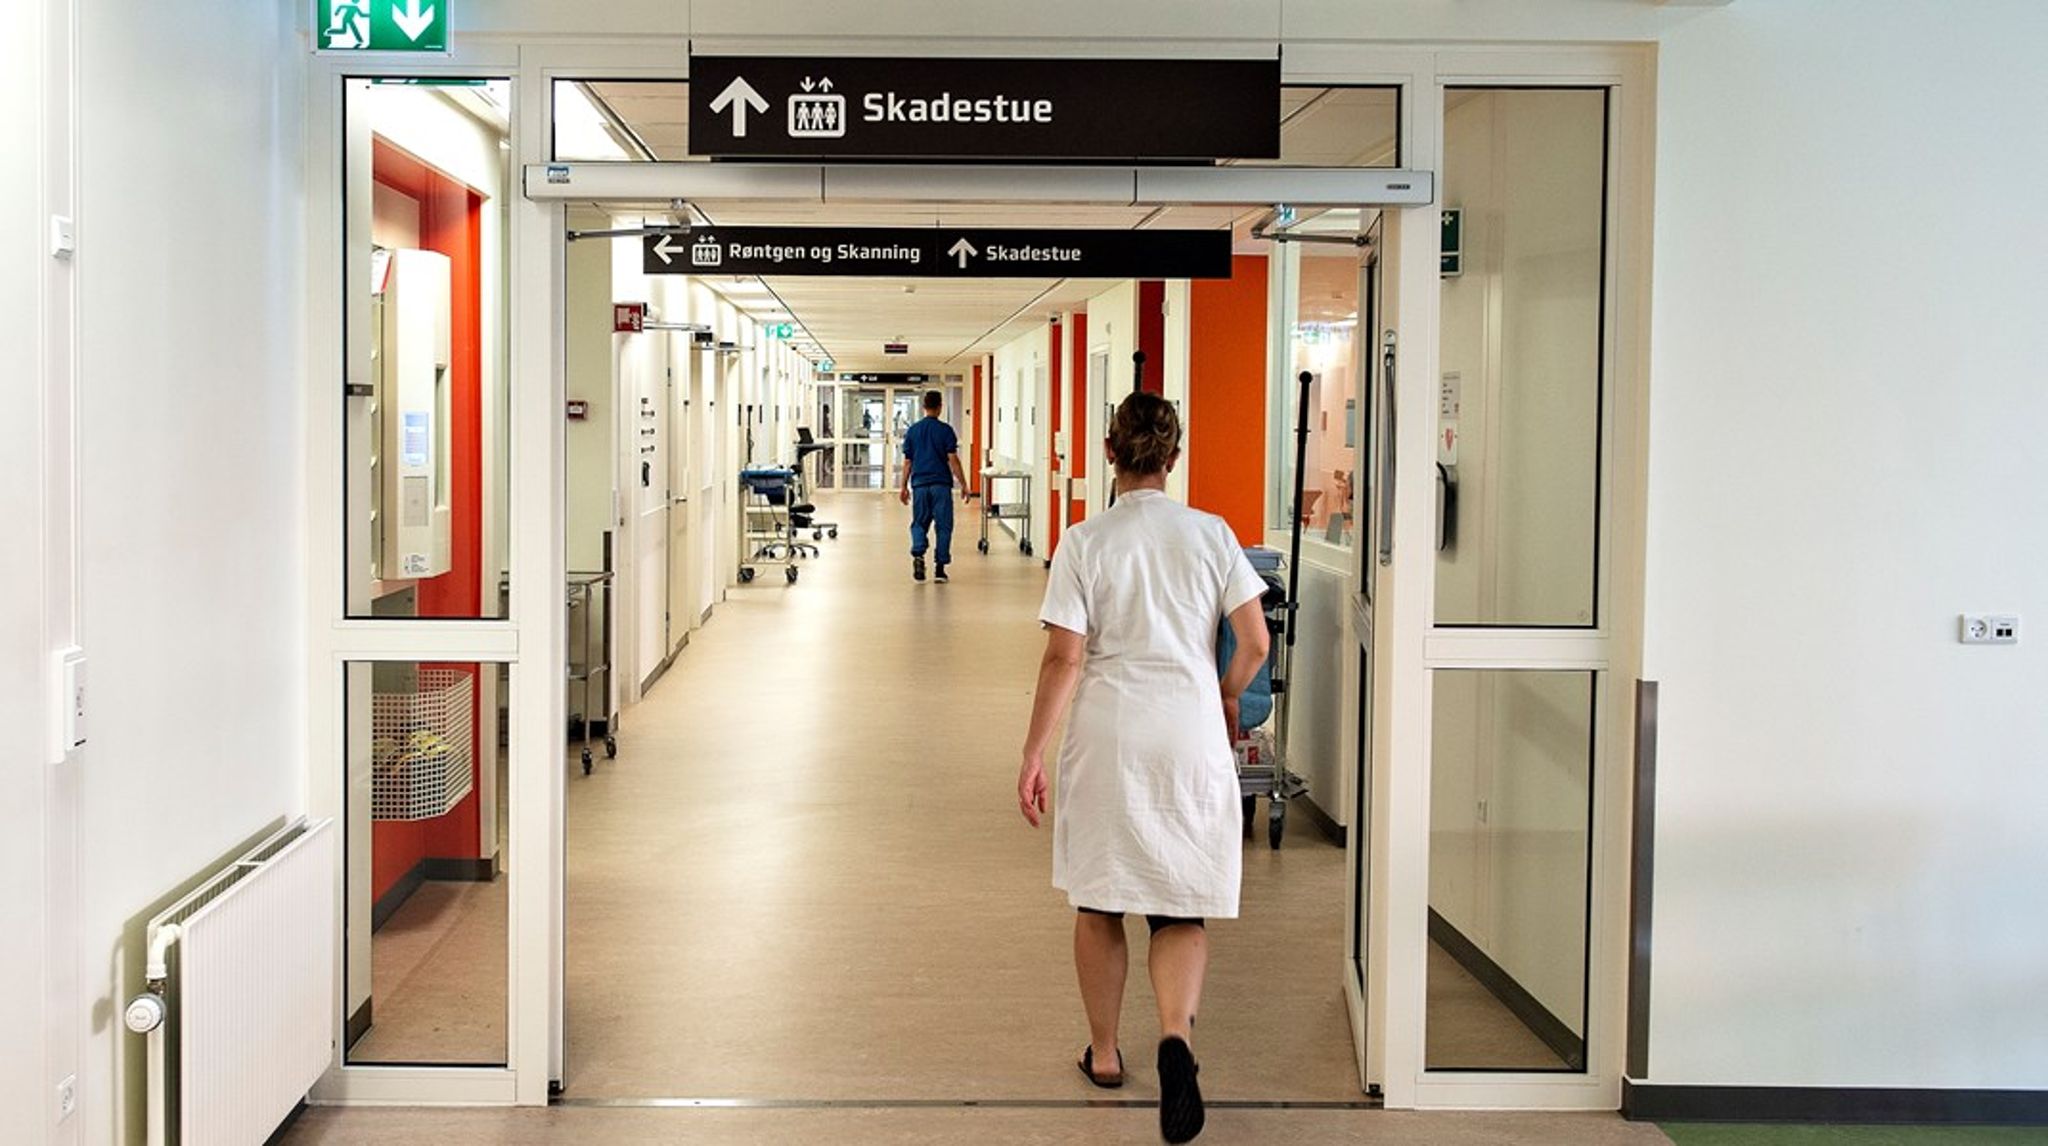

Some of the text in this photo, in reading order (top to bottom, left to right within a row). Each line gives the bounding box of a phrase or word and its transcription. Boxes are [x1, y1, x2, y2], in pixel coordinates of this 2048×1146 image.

[863, 91, 1053, 124] Skadestue
[729, 243, 921, 265] Røntgen og Skanning
[985, 245, 1082, 263] Skadestue
